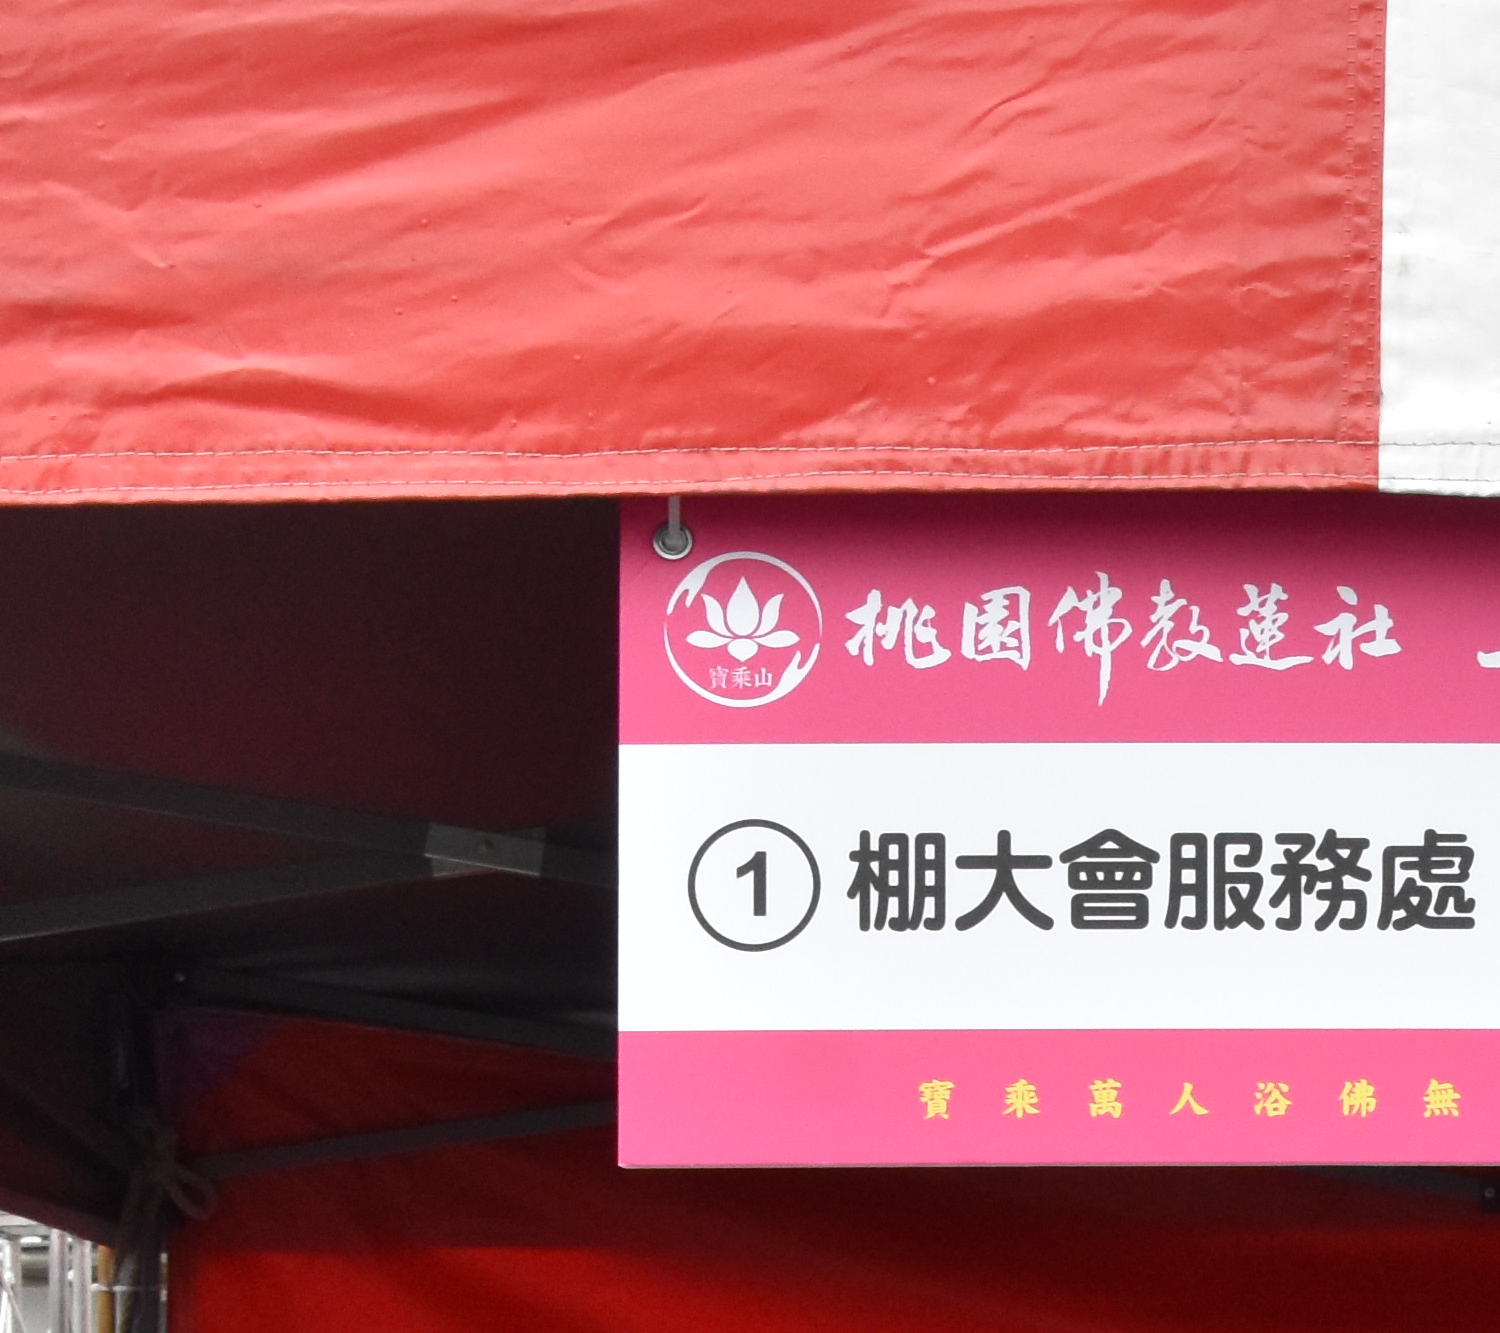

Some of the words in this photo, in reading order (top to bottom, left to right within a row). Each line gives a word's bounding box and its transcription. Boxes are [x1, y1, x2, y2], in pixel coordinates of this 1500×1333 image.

[709, 666, 773, 689] 寶乘山
[845, 573, 1402, 707] 桃園佛教蓮社
[847, 828, 1478, 933] 棚大會服務處
